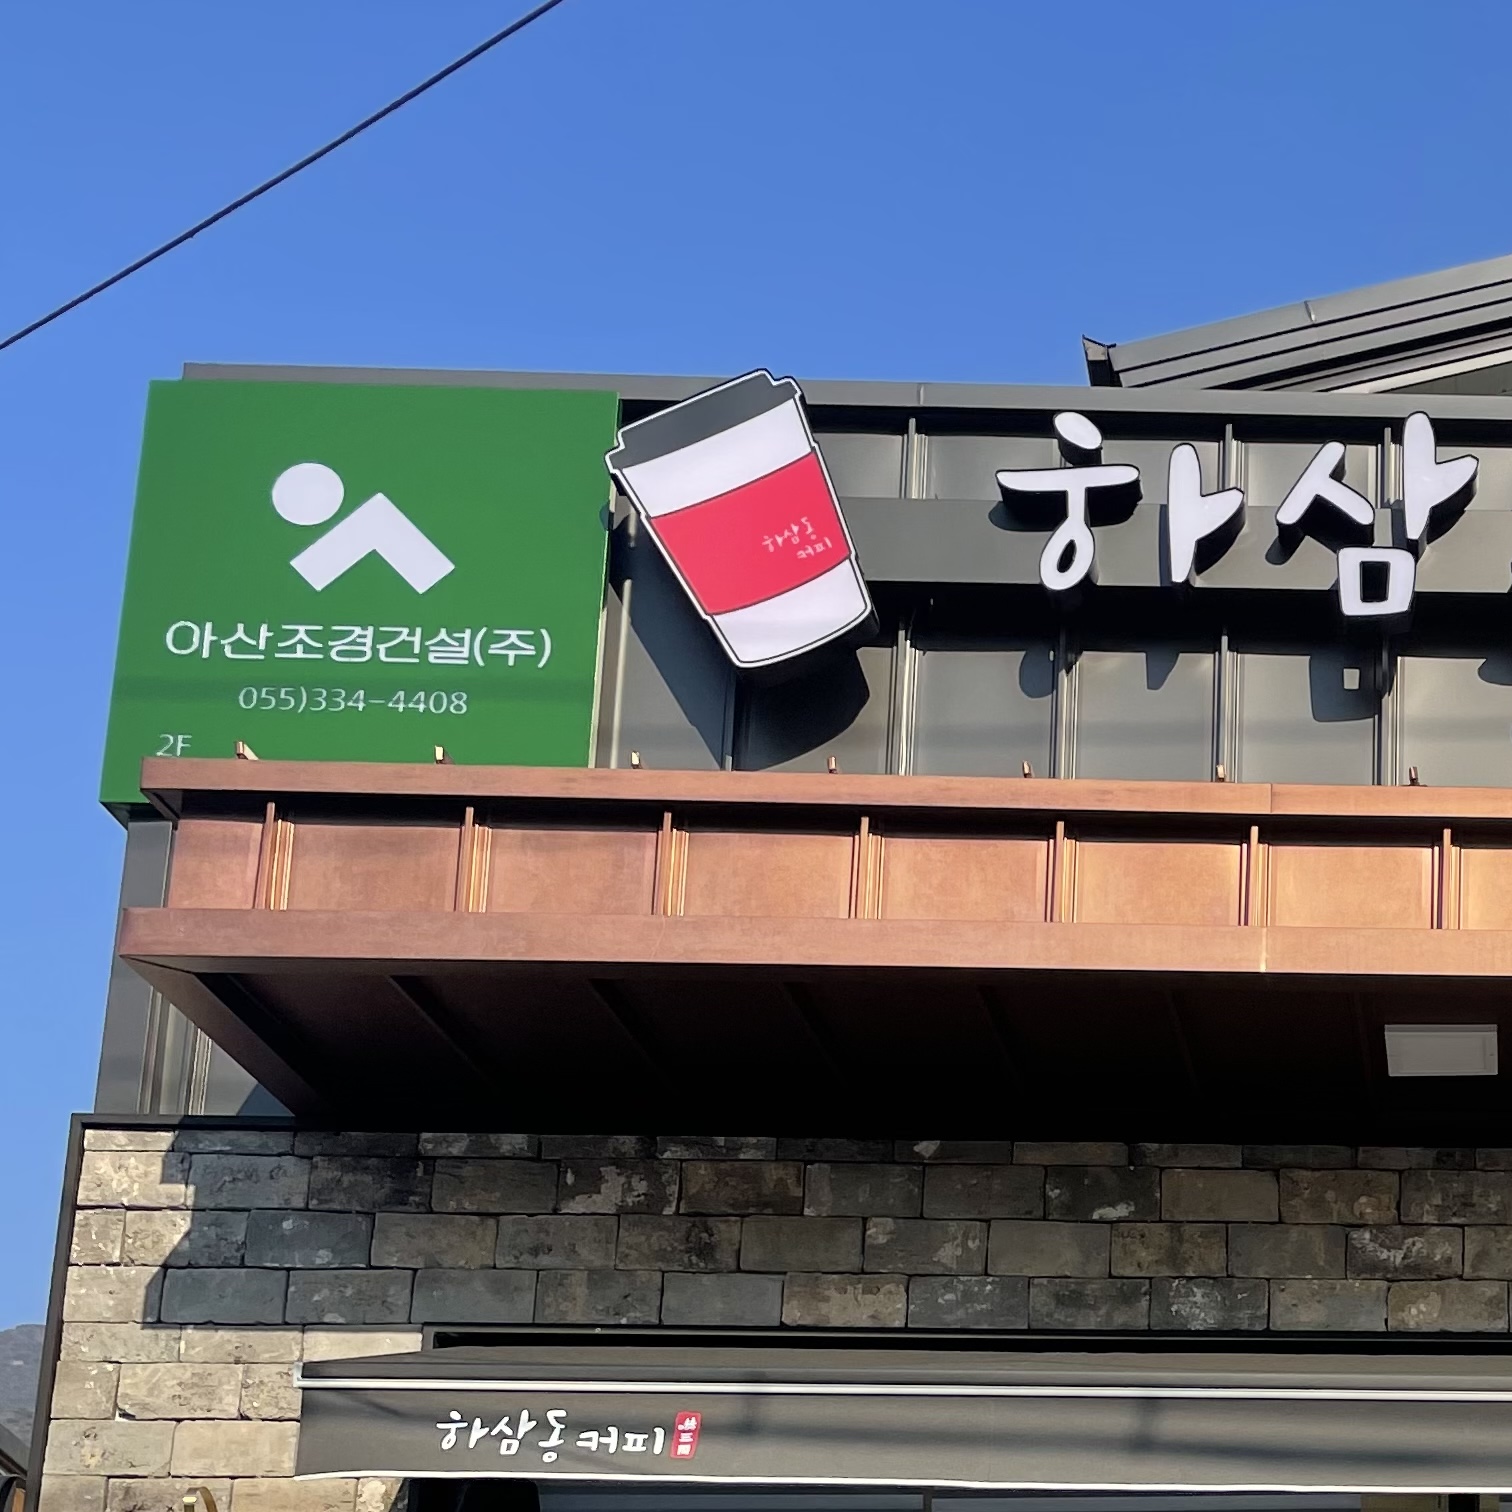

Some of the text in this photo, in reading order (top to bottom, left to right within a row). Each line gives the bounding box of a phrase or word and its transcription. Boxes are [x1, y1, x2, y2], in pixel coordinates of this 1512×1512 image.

[762, 517, 816, 552] 하삼동
[797, 537, 832, 558] 커피
[165, 620, 551, 668] 아산조경건설(주)
[238, 686, 468, 716] 055)334-4408
[156, 734, 192, 756] 2F
